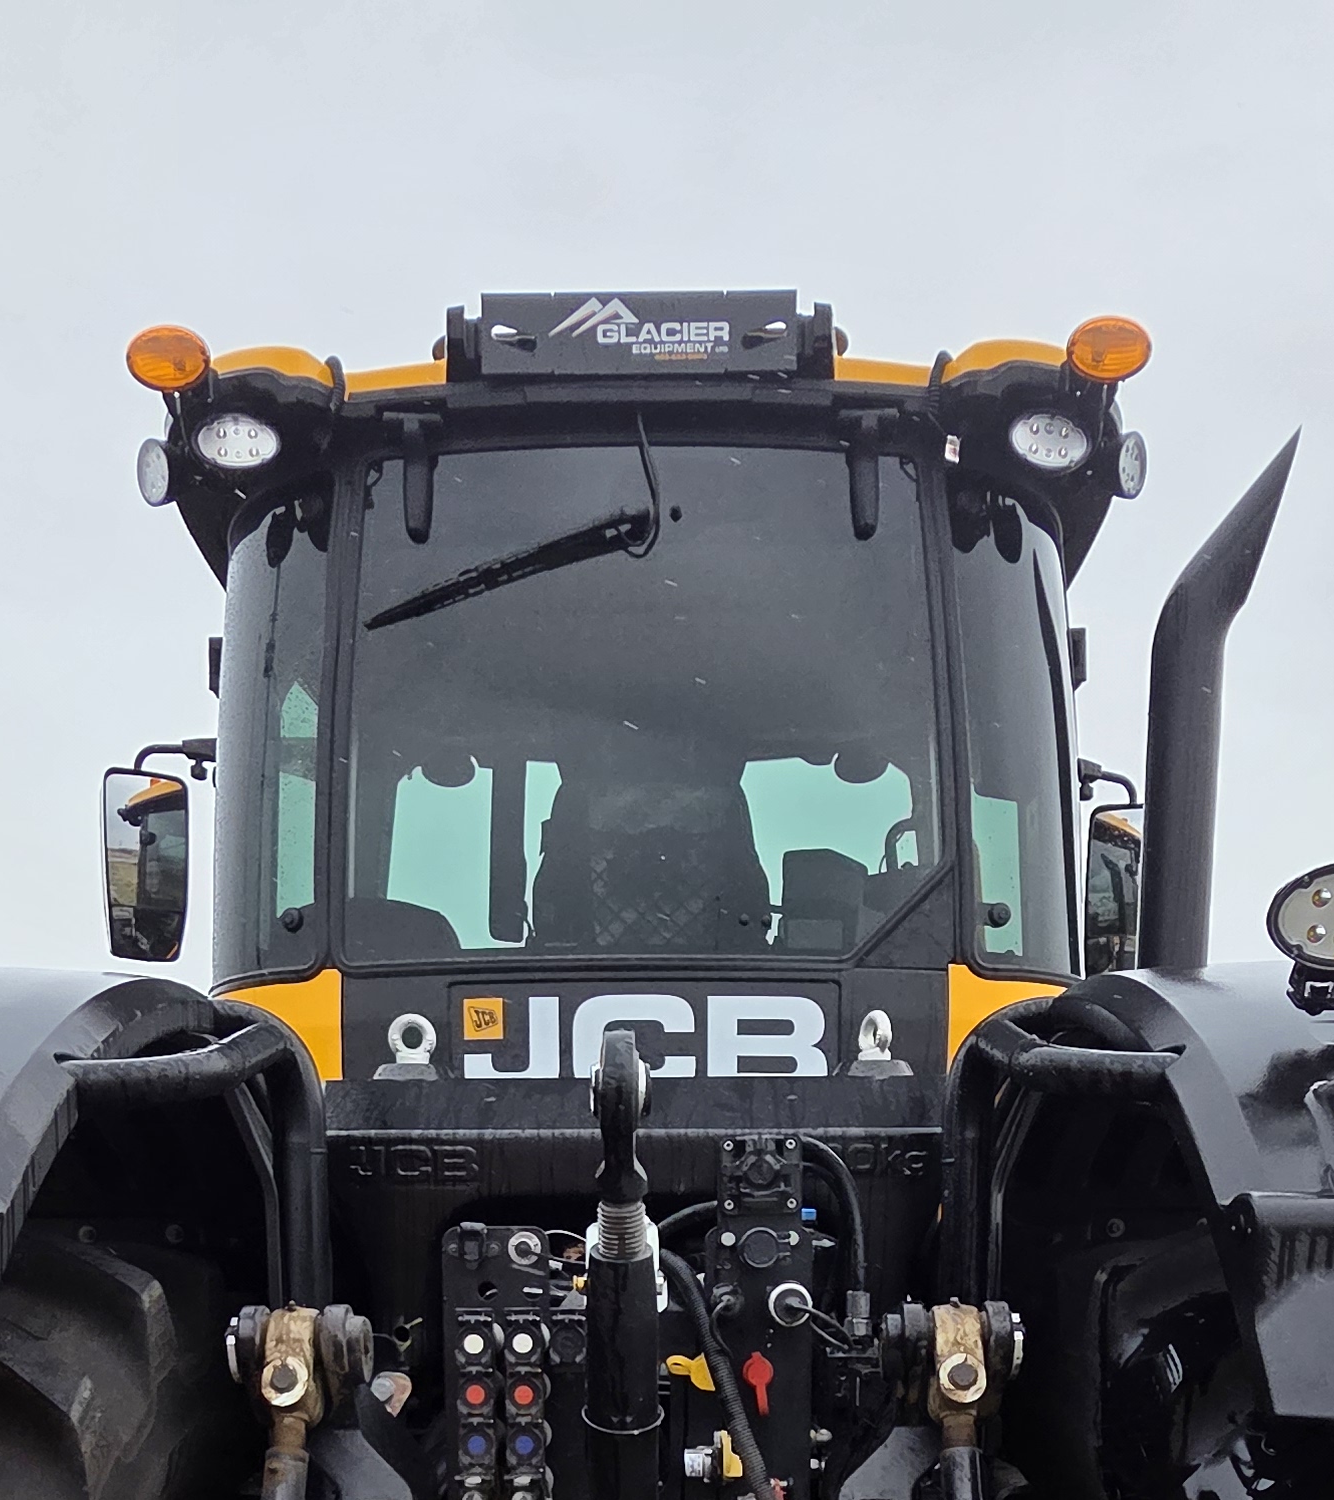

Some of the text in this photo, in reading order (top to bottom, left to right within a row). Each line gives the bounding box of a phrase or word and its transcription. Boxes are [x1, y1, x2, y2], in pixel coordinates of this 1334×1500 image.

[596, 321, 730, 344] GLACIER
[632, 342, 714, 354] EQUIPMENT
[473, 1008, 497, 1029] JCB
[463, 994, 829, 1078] JCB
